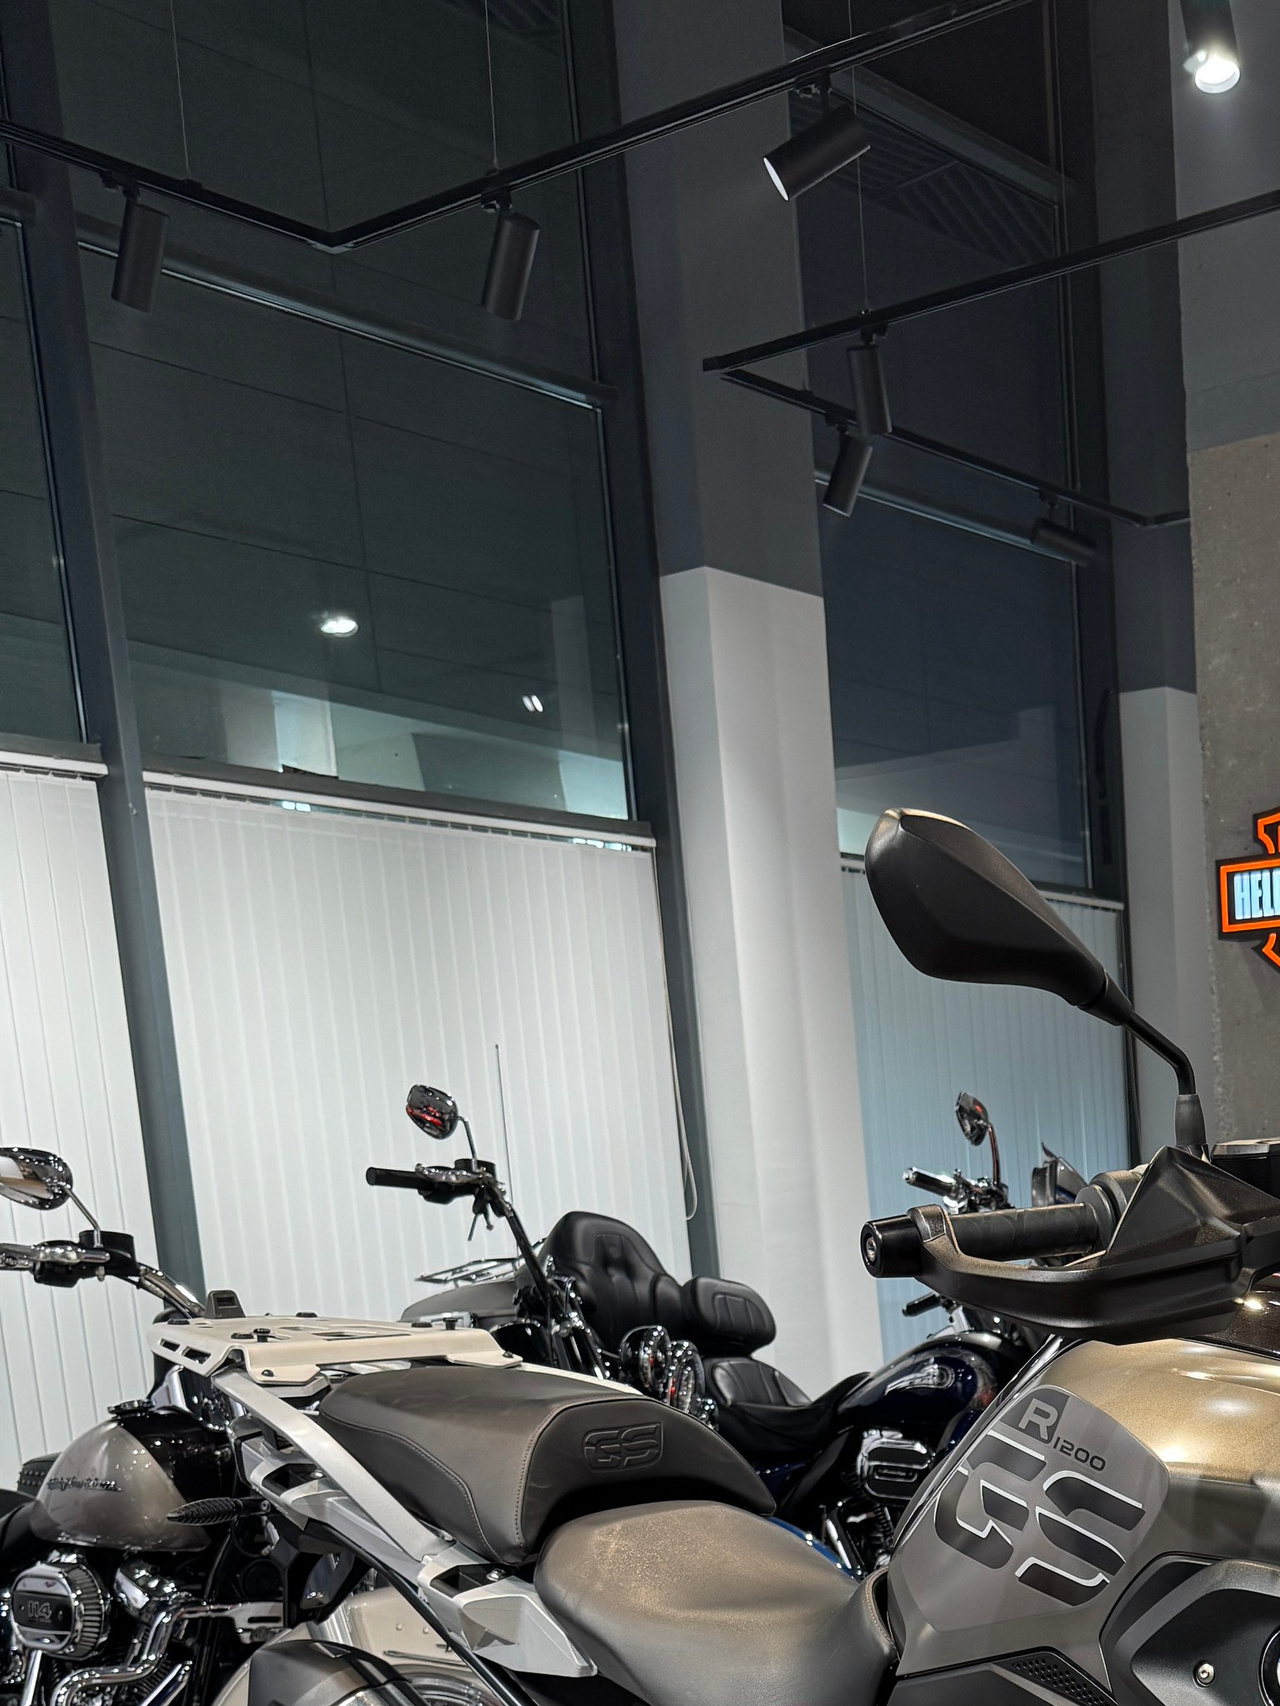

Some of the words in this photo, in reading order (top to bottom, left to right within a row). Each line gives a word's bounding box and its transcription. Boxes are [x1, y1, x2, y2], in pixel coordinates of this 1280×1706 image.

[582, 1421, 661, 1471] GS
[1018, 1397, 1059, 1441] R
[1052, 1436, 1106, 1472] 1200
[27, 1600, 52, 1620] 114
